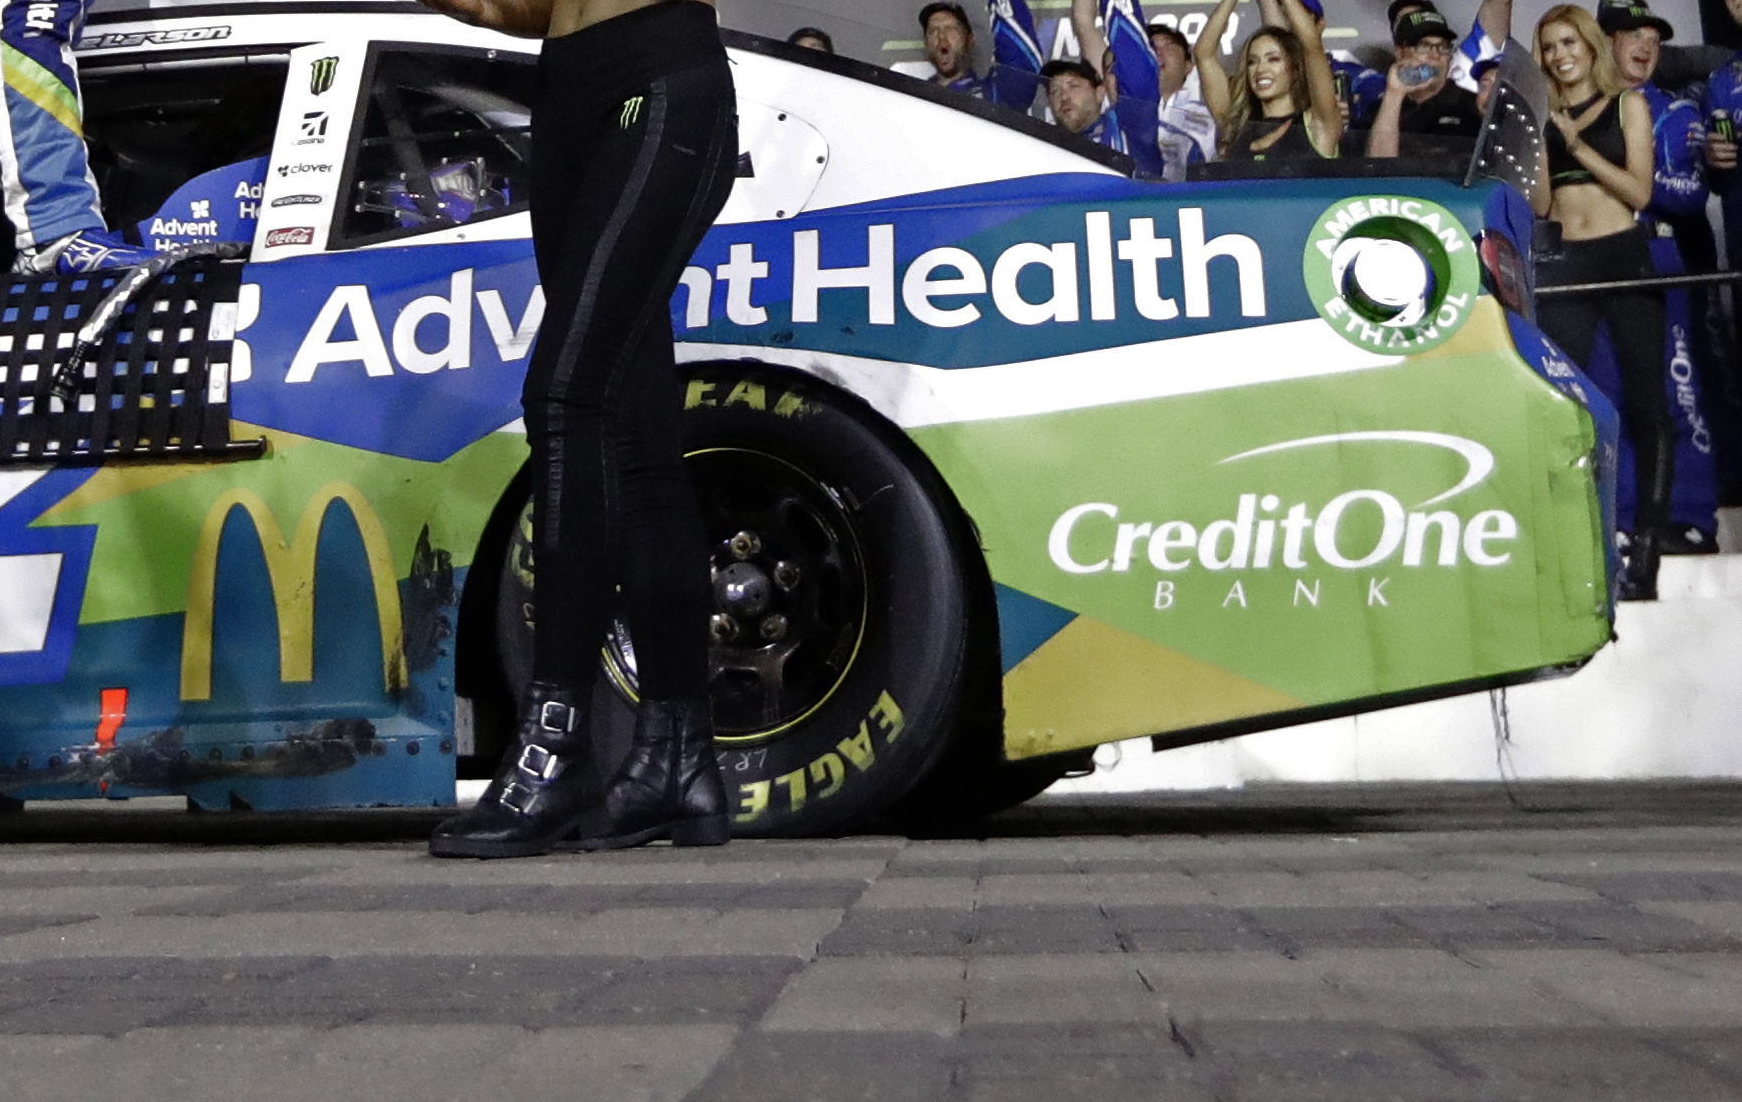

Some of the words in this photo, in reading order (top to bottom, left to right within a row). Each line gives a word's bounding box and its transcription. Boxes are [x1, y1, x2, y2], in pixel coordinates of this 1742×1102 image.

[291, 162, 333, 174] clover
[150, 218, 218, 236] Advent
[1315, 197, 1465, 260] AMERICAN
[284, 243, 770, 384] Advnt
[1324, 292, 1469, 348] ETHANOL
[1152, 578, 1391, 611] BANK
[735, 689, 905, 823] EAGLE
